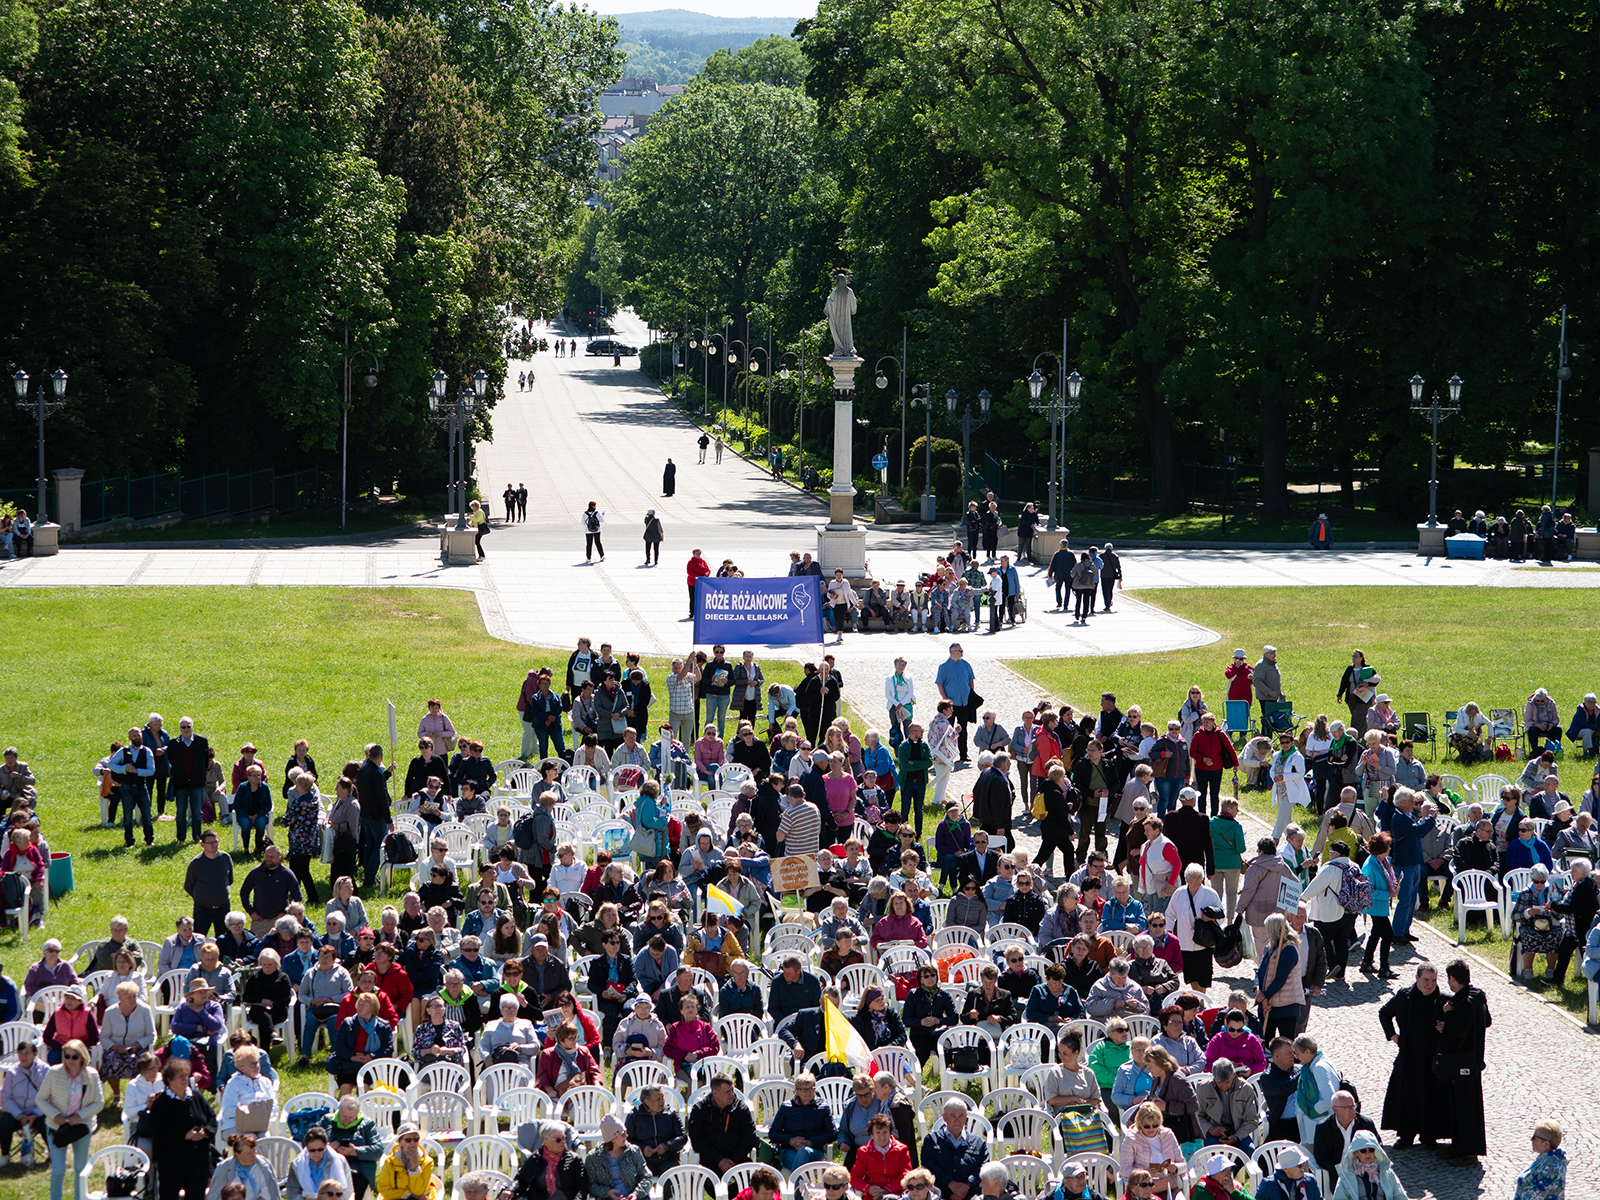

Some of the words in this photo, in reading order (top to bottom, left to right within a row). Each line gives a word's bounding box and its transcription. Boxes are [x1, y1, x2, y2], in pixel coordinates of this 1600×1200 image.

[705, 590, 729, 610] RÓŻE
[731, 590, 788, 611] RÓŻAŃCOWE
[705, 613, 745, 621] DIECEZJA
[747, 613, 788, 622] ELBLĄSKA
